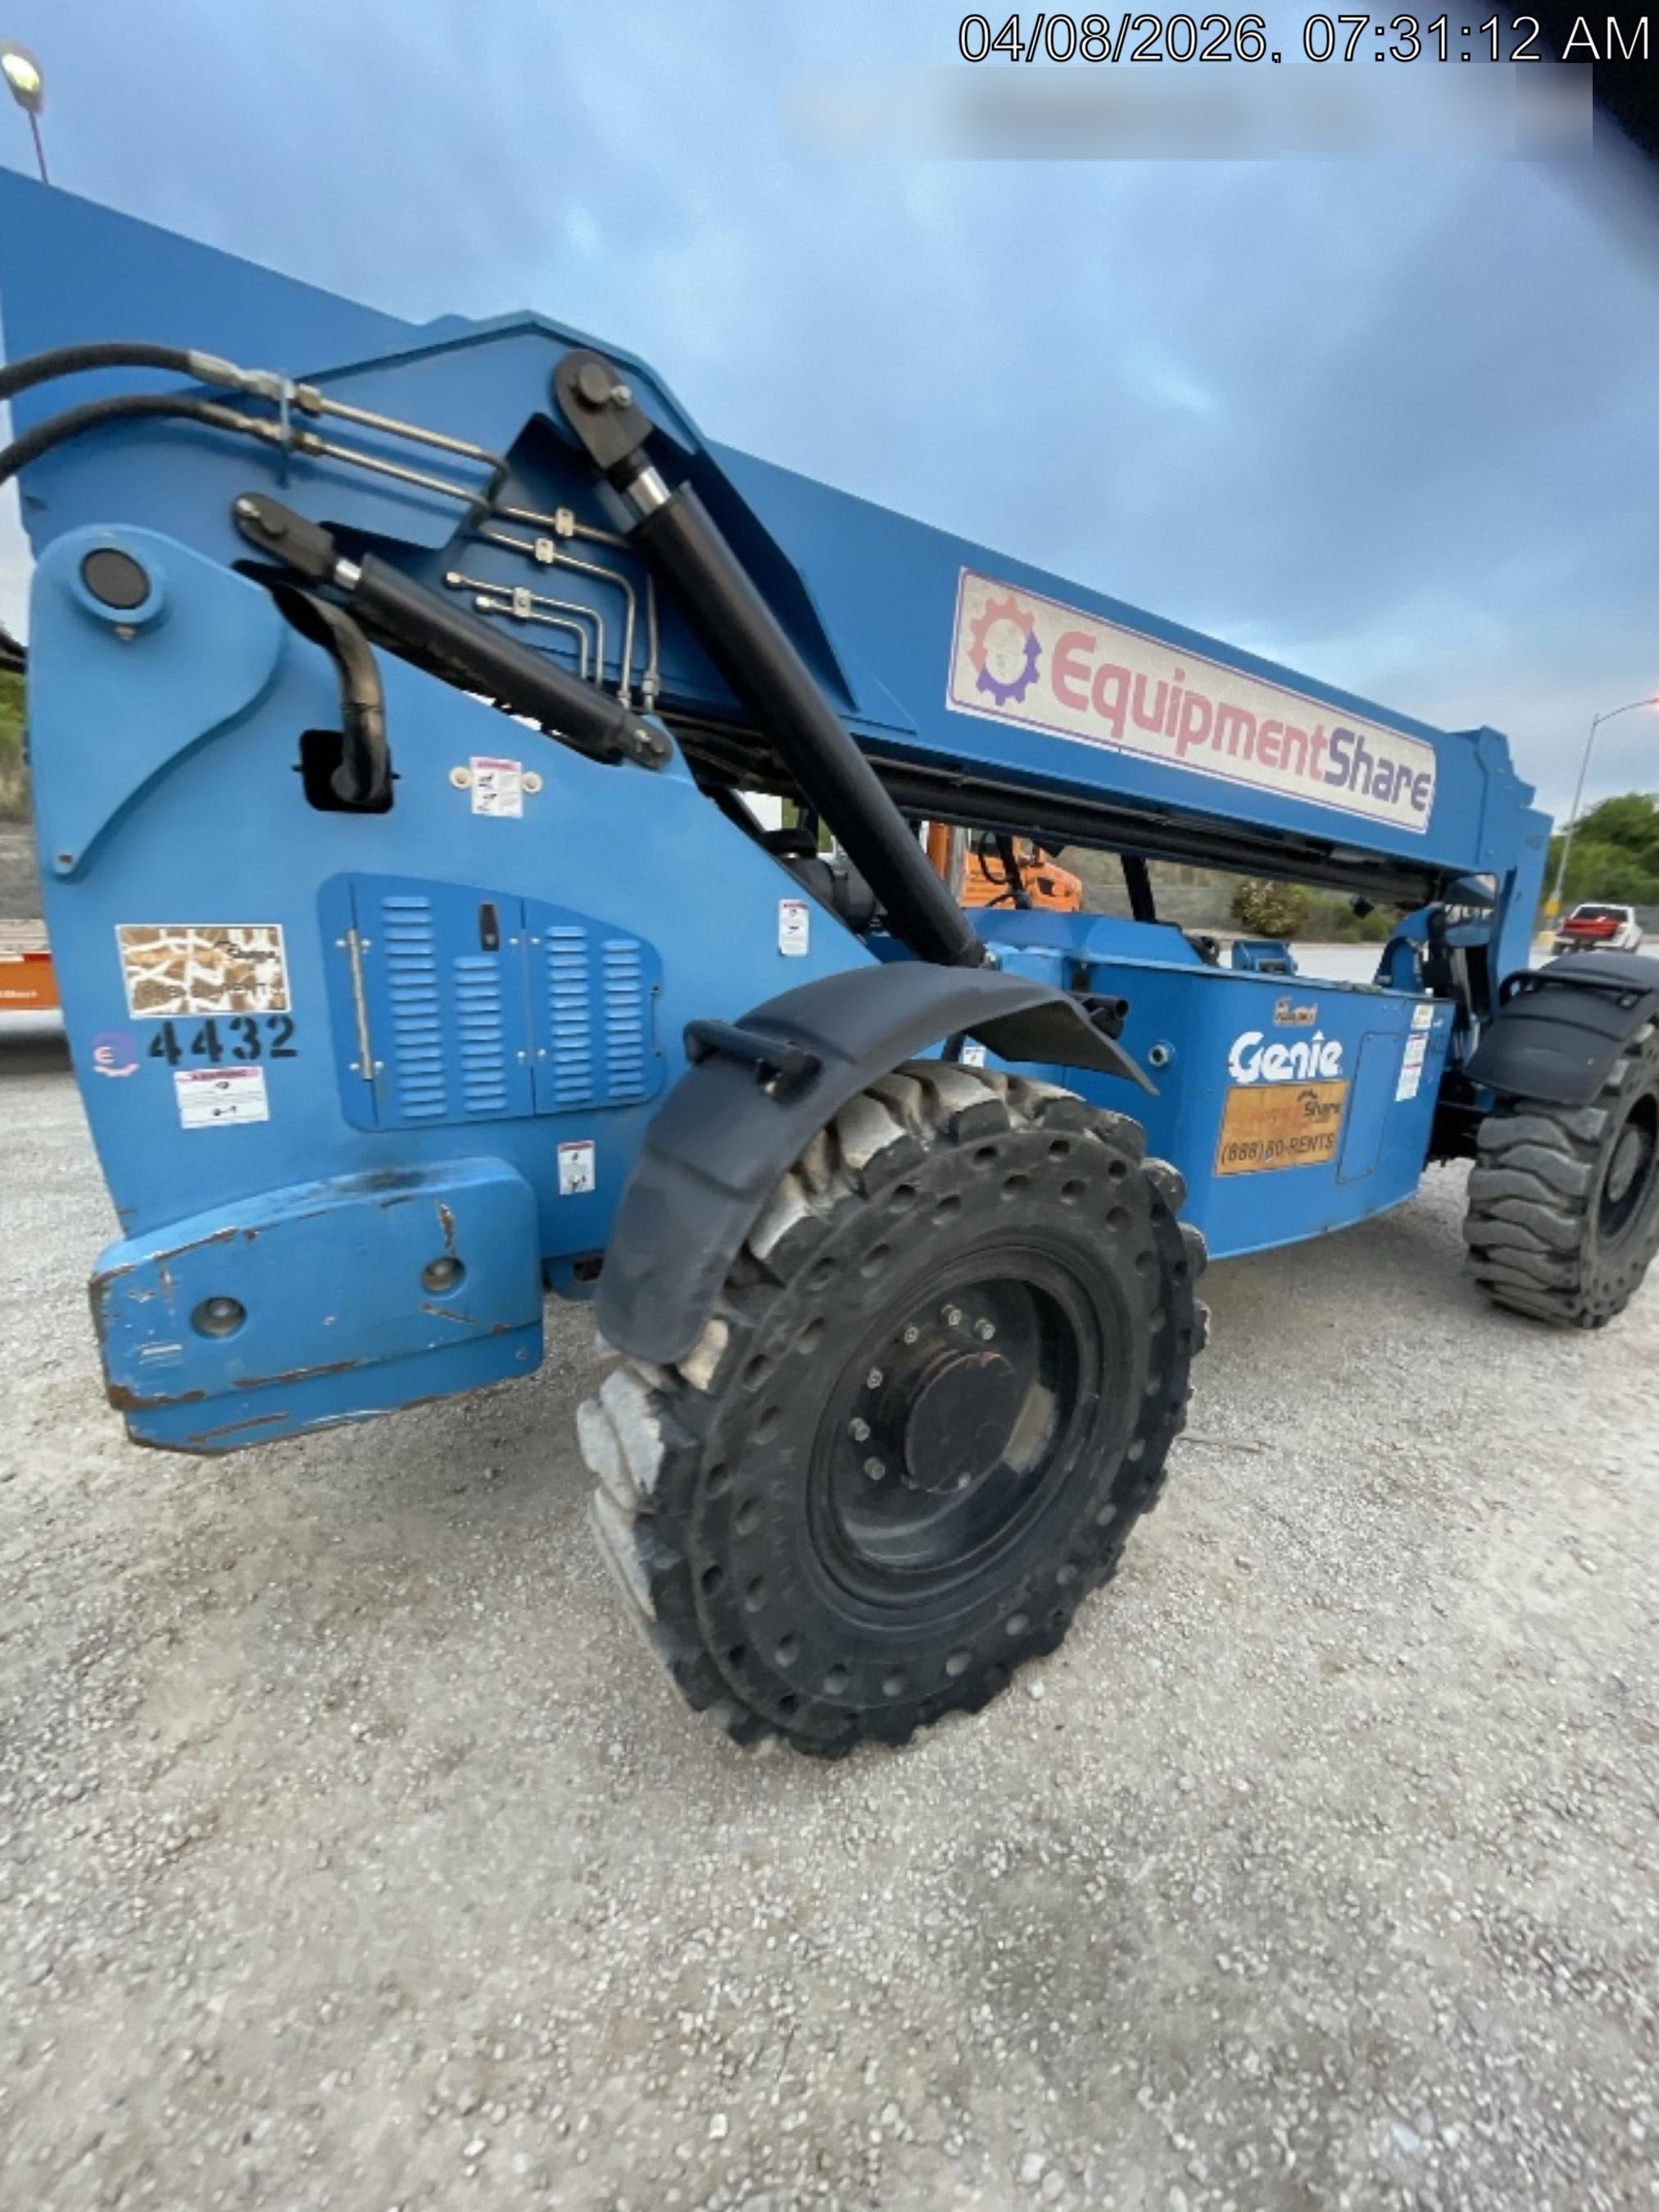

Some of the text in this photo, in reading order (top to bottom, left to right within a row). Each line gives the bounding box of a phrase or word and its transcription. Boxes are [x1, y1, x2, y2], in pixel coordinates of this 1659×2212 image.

[1051, 631, 1431, 811] EquipmentShare
[147, 1016, 297, 1066] 4432
[1228, 1028, 1344, 1084] Genie
